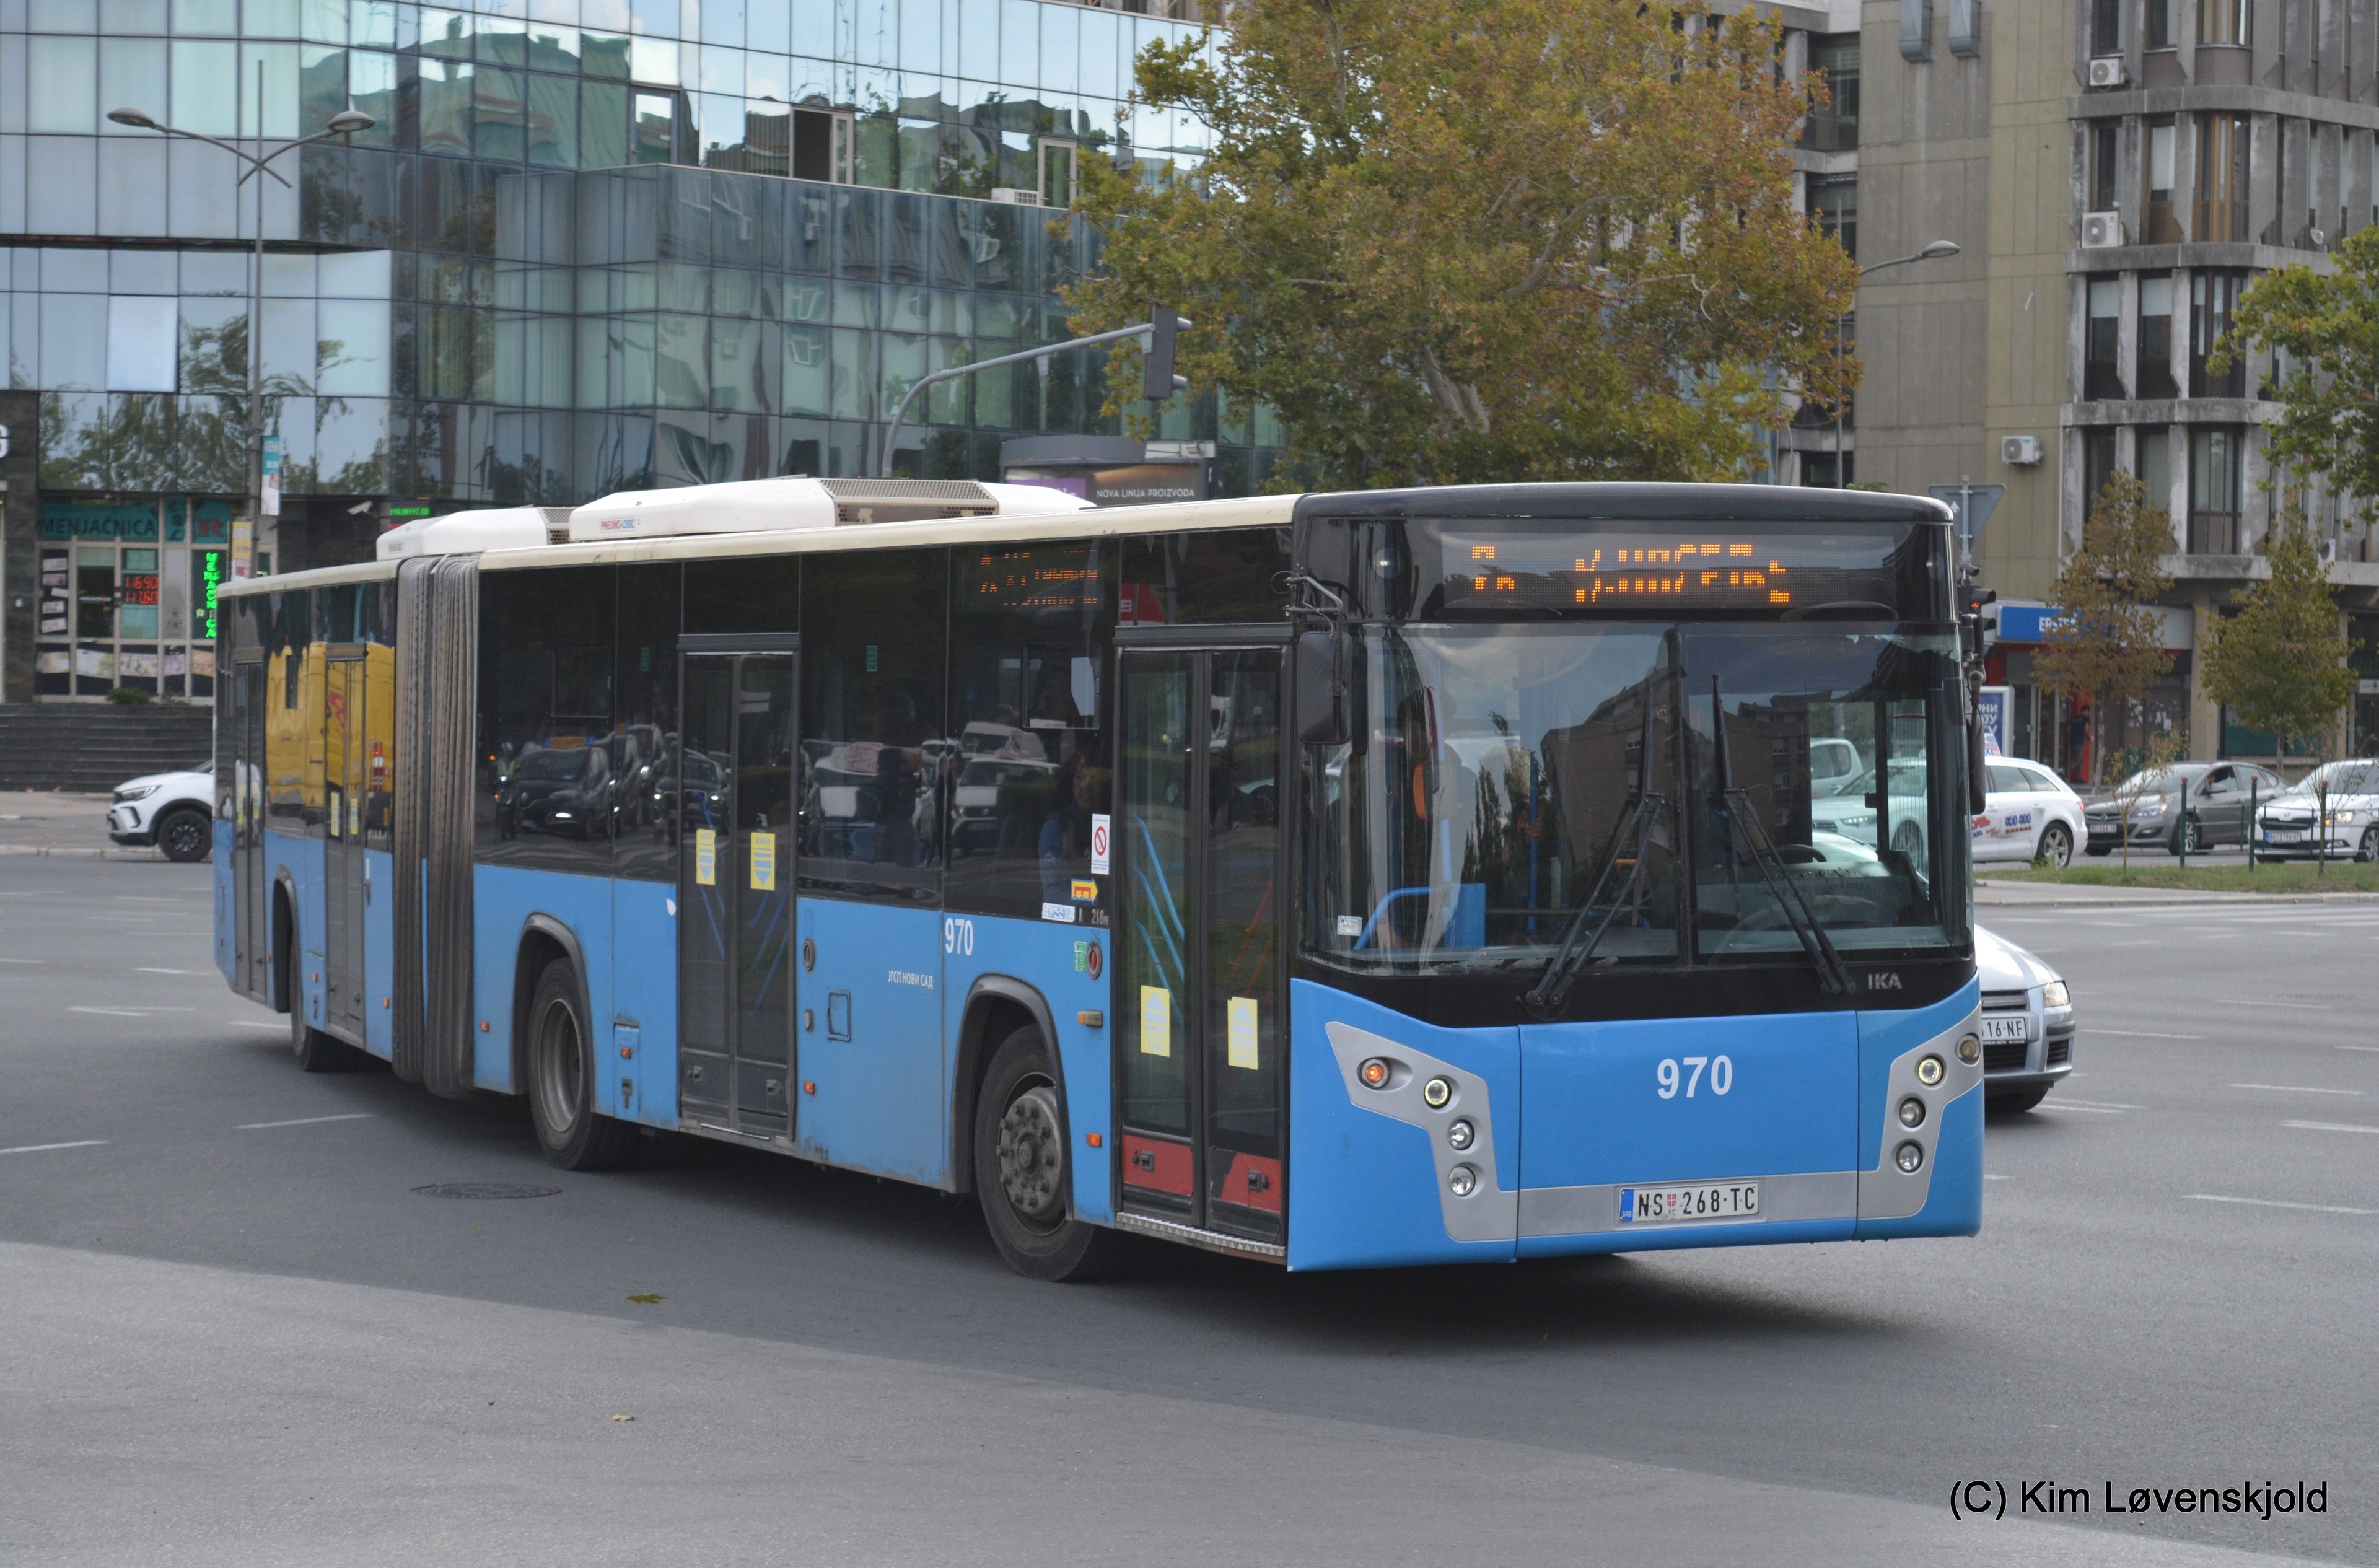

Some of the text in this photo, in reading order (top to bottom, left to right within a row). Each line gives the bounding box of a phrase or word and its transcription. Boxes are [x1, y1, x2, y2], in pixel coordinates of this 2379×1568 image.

[1097, 488, 1194, 498] NOVA LINIJA PROIZVODA
[945, 918, 973, 956] 970
[902, 971, 919, 986] НОВИ
[920, 974, 933, 990] САД
[1868, 972, 1903, 990] IKA
[1657, 1055, 1733, 1100] 970
[1638, 1193, 1663, 1217] NS
